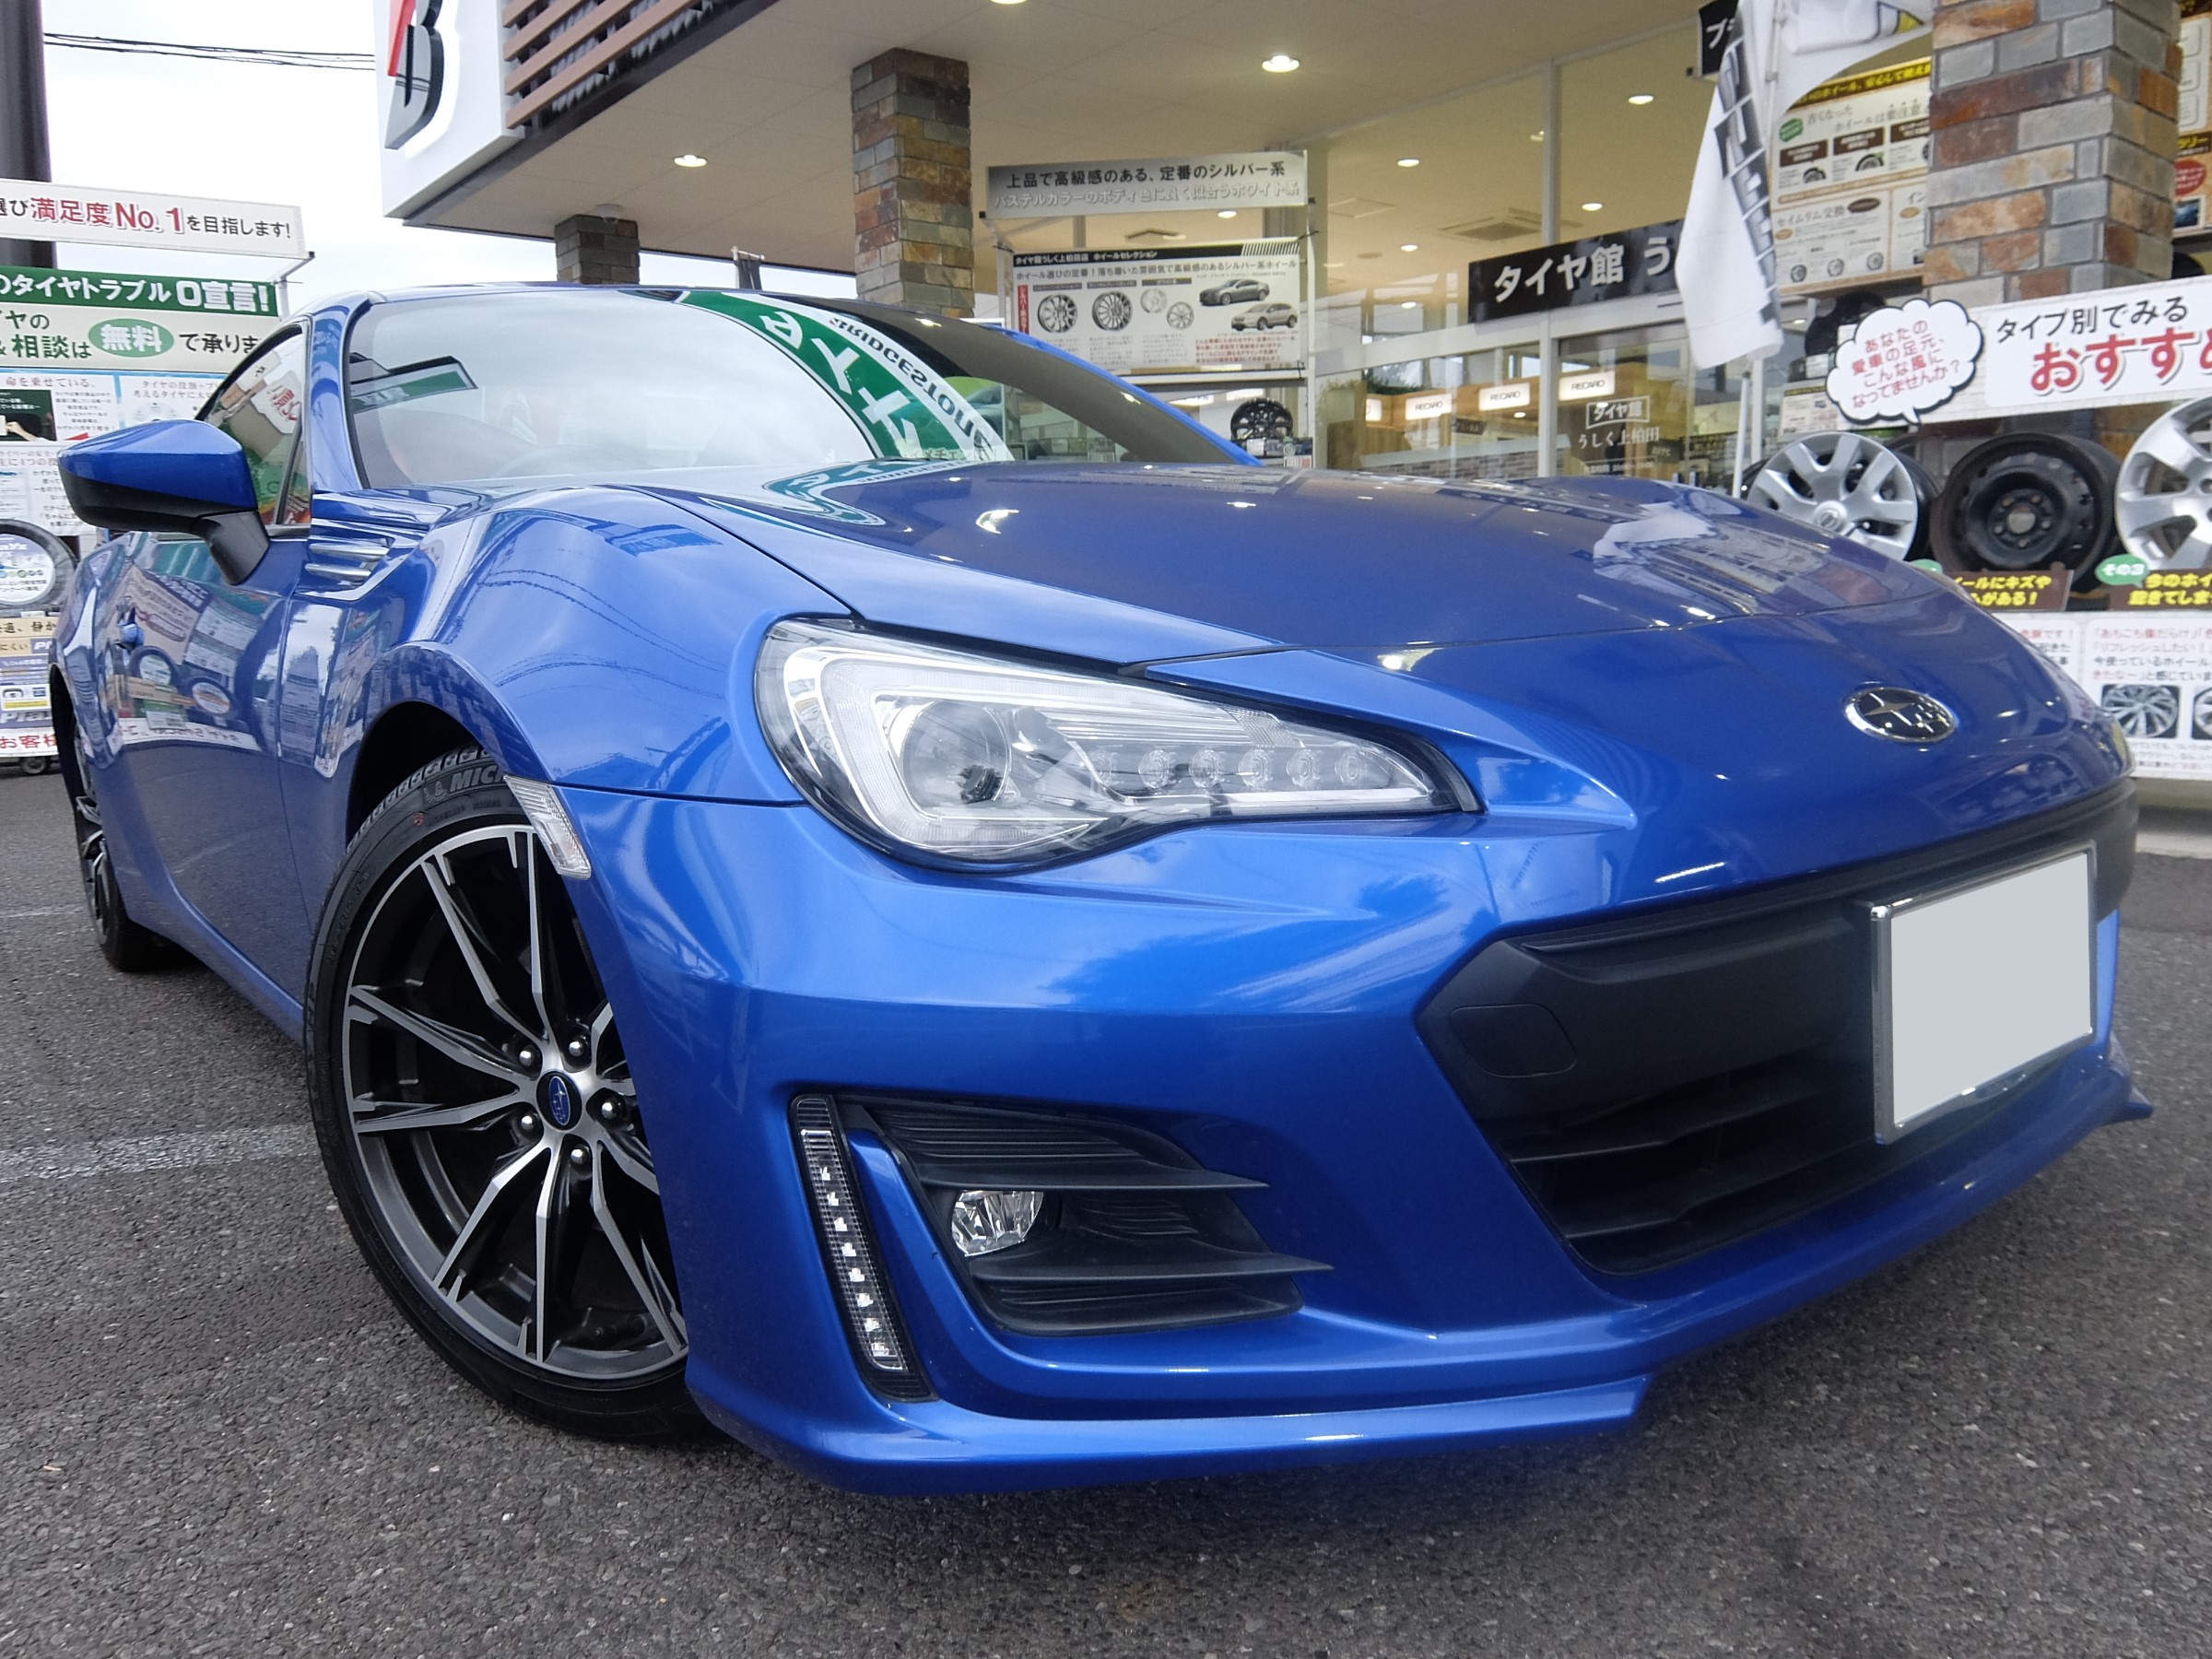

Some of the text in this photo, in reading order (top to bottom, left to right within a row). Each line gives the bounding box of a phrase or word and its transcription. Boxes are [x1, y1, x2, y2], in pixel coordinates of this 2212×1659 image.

[1006, 160, 1286, 189] 上品で高級感のある、定番のシルバー系
[1493, 236, 1671, 303] タイヤ館 う
[0, 310, 50, 330] ヤの
[1996, 296, 2188, 344] タイプ別でみる
[100, 324, 163, 353] 無料
[1865, 320, 1928, 353] あなたの
[1852, 333, 1945, 376] 愛車の足元、
[1864, 348, 1944, 388] こんな風に
[1489, 390, 1521, 402] RECARO
[1571, 380, 1606, 392] RECARO
[1414, 400, 1443, 411] RECARO
[1594, 400, 1642, 422] タイヤ館
[2127, 589, 2212, 606] 飽きてしま
